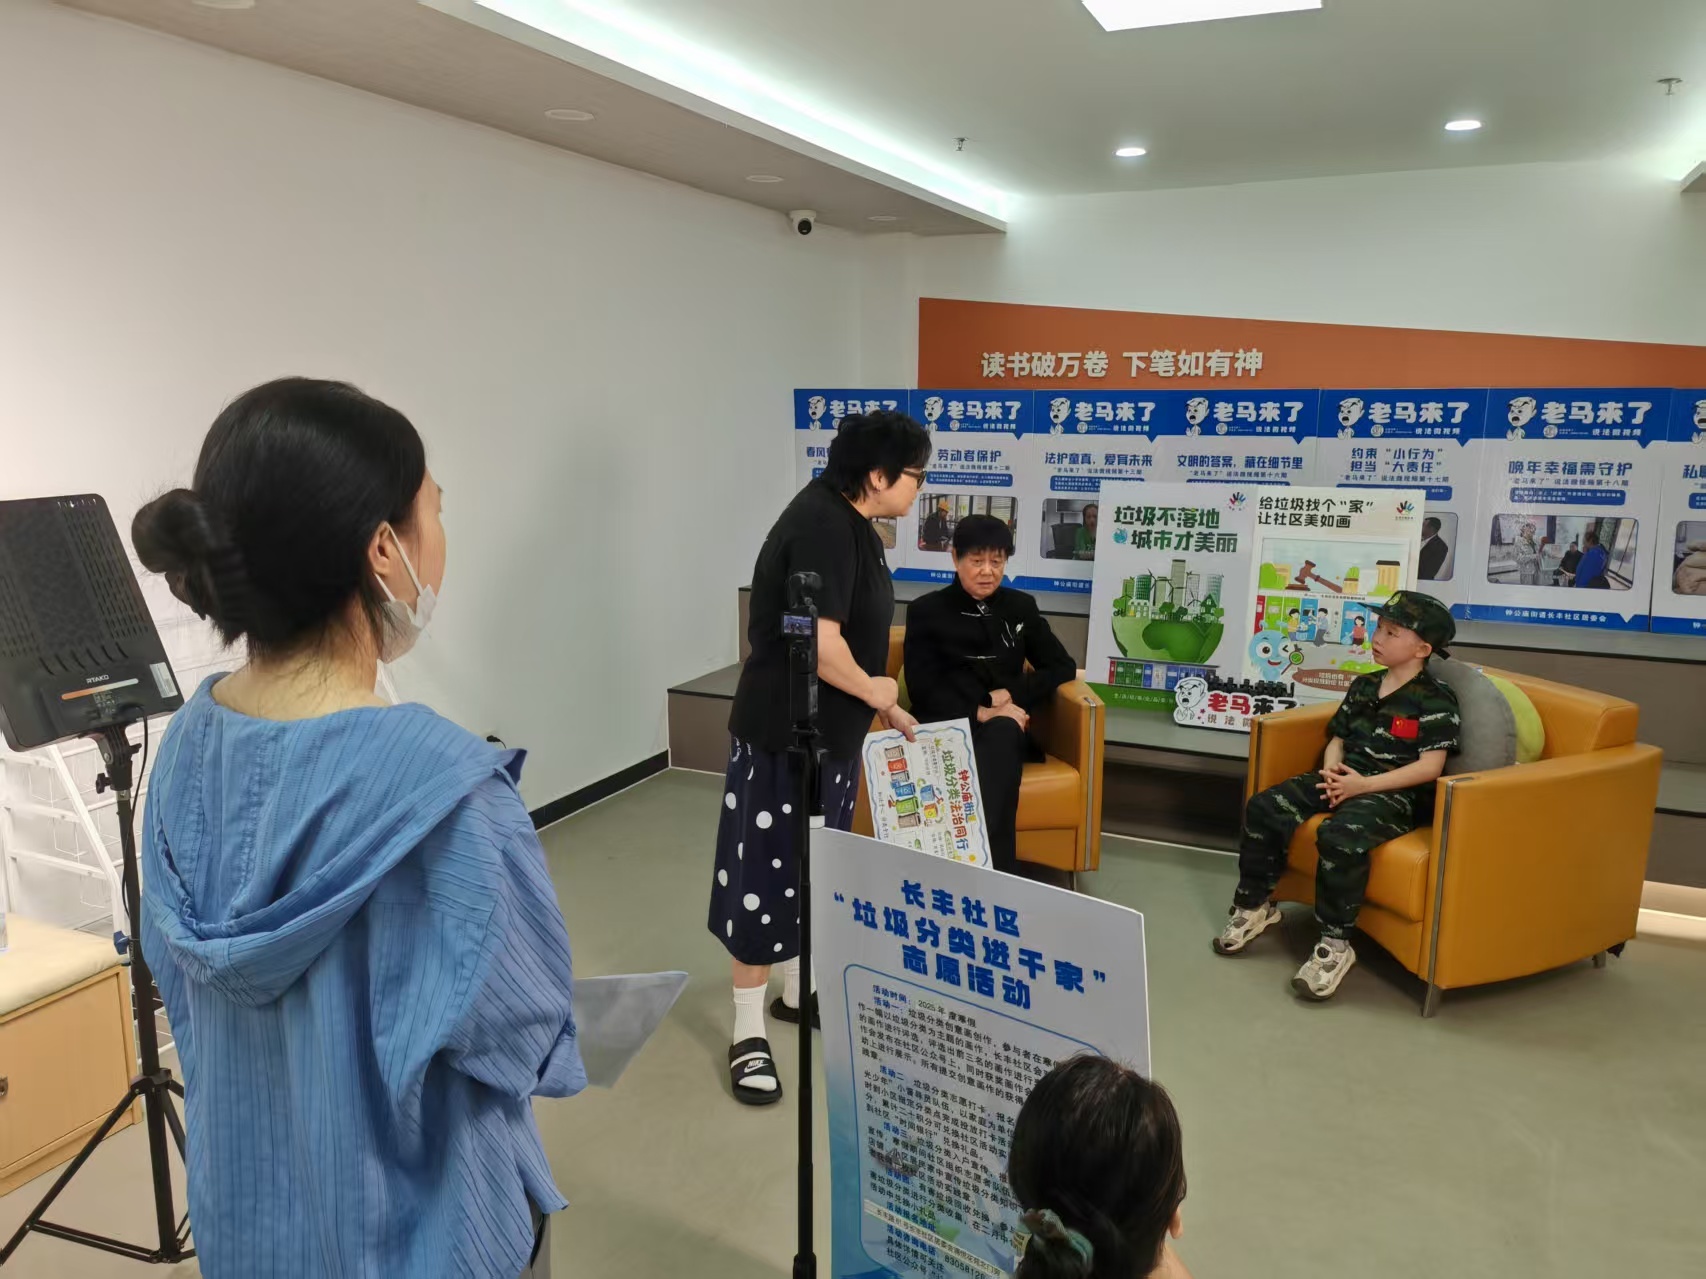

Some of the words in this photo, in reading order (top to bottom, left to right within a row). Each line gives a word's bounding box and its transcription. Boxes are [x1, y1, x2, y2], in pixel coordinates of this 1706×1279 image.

[981, 351, 1109, 378] 读书破万卷
[1122, 349, 1264, 378] 下笔如有神
[947, 401, 1022, 420] 老马来了
[1075, 401, 1156, 421] 老马来了
[1213, 401, 1304, 422] 老马来了
[1368, 402, 1470, 424] 老马来了
[1541, 401, 1653, 424] 老马来了
[937, 448, 1002, 463] 劳动者保护
[1508, 460, 1632, 477] 晚年幸福需守护
[1113, 505, 1220, 530] 垃圾不落地
[1257, 511, 1352, 529] 让社区美如画
[1130, 529, 1238, 553] 城市才美丽
[900, 879, 1020, 938] 长丰社区
[901, 943, 1031, 1010] 志愿活动
